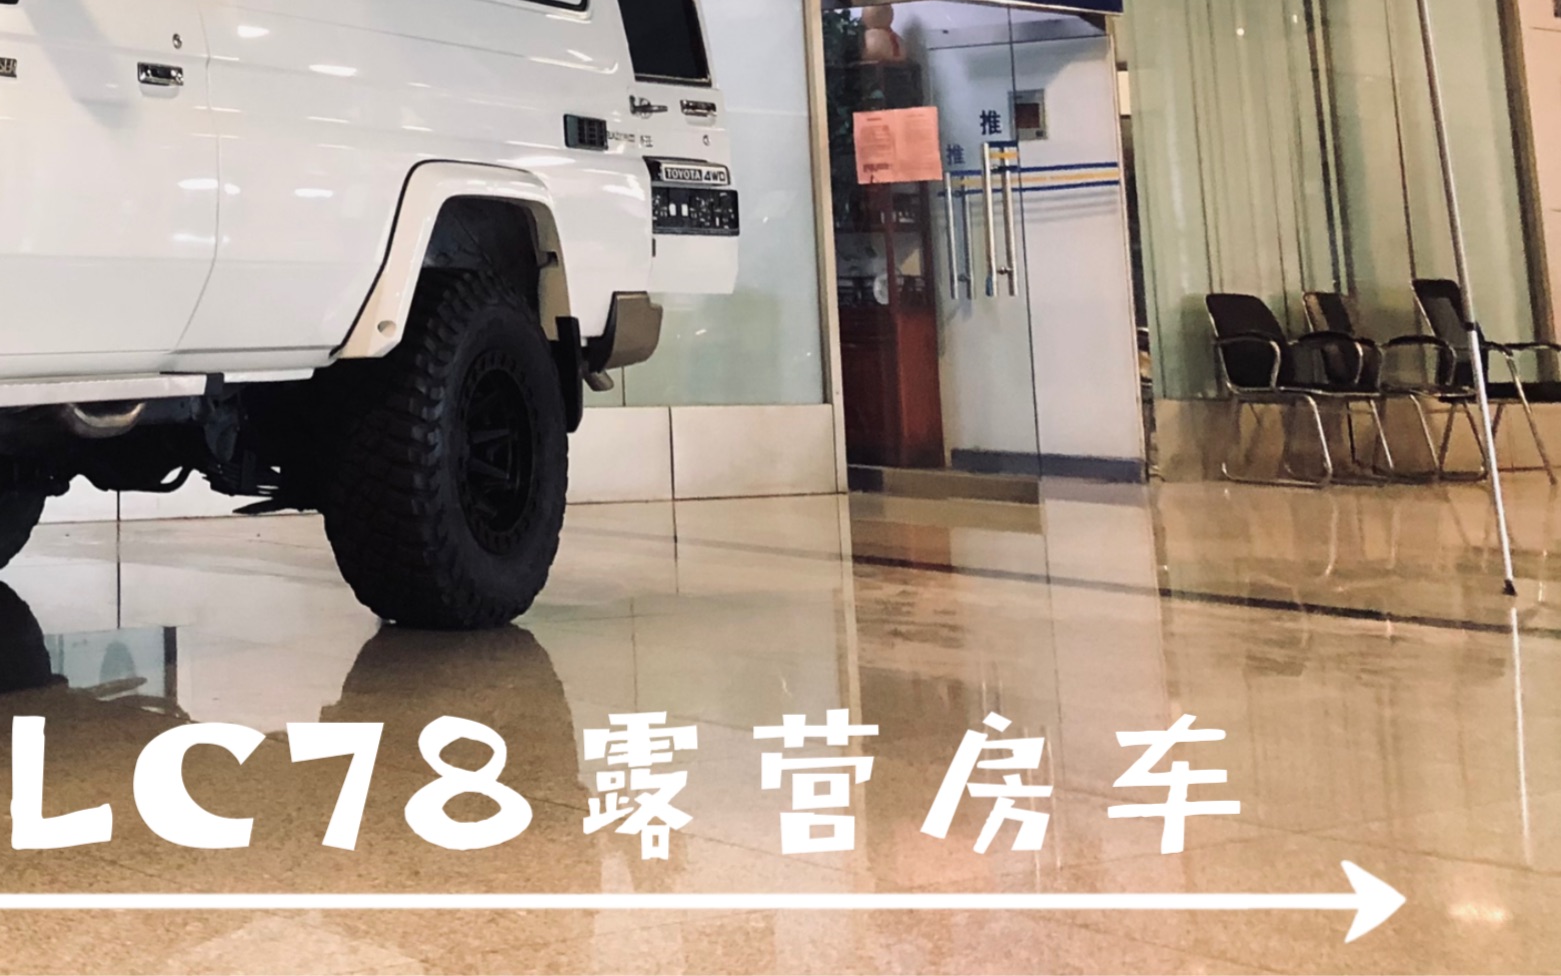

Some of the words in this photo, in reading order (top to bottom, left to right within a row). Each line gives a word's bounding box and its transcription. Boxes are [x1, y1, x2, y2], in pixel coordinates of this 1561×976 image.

[980, 110, 1002, 136] 推
[946, 143, 965, 166] 推
[666, 168, 702, 182] TOYOTA
[704, 171, 726, 182] 4WD
